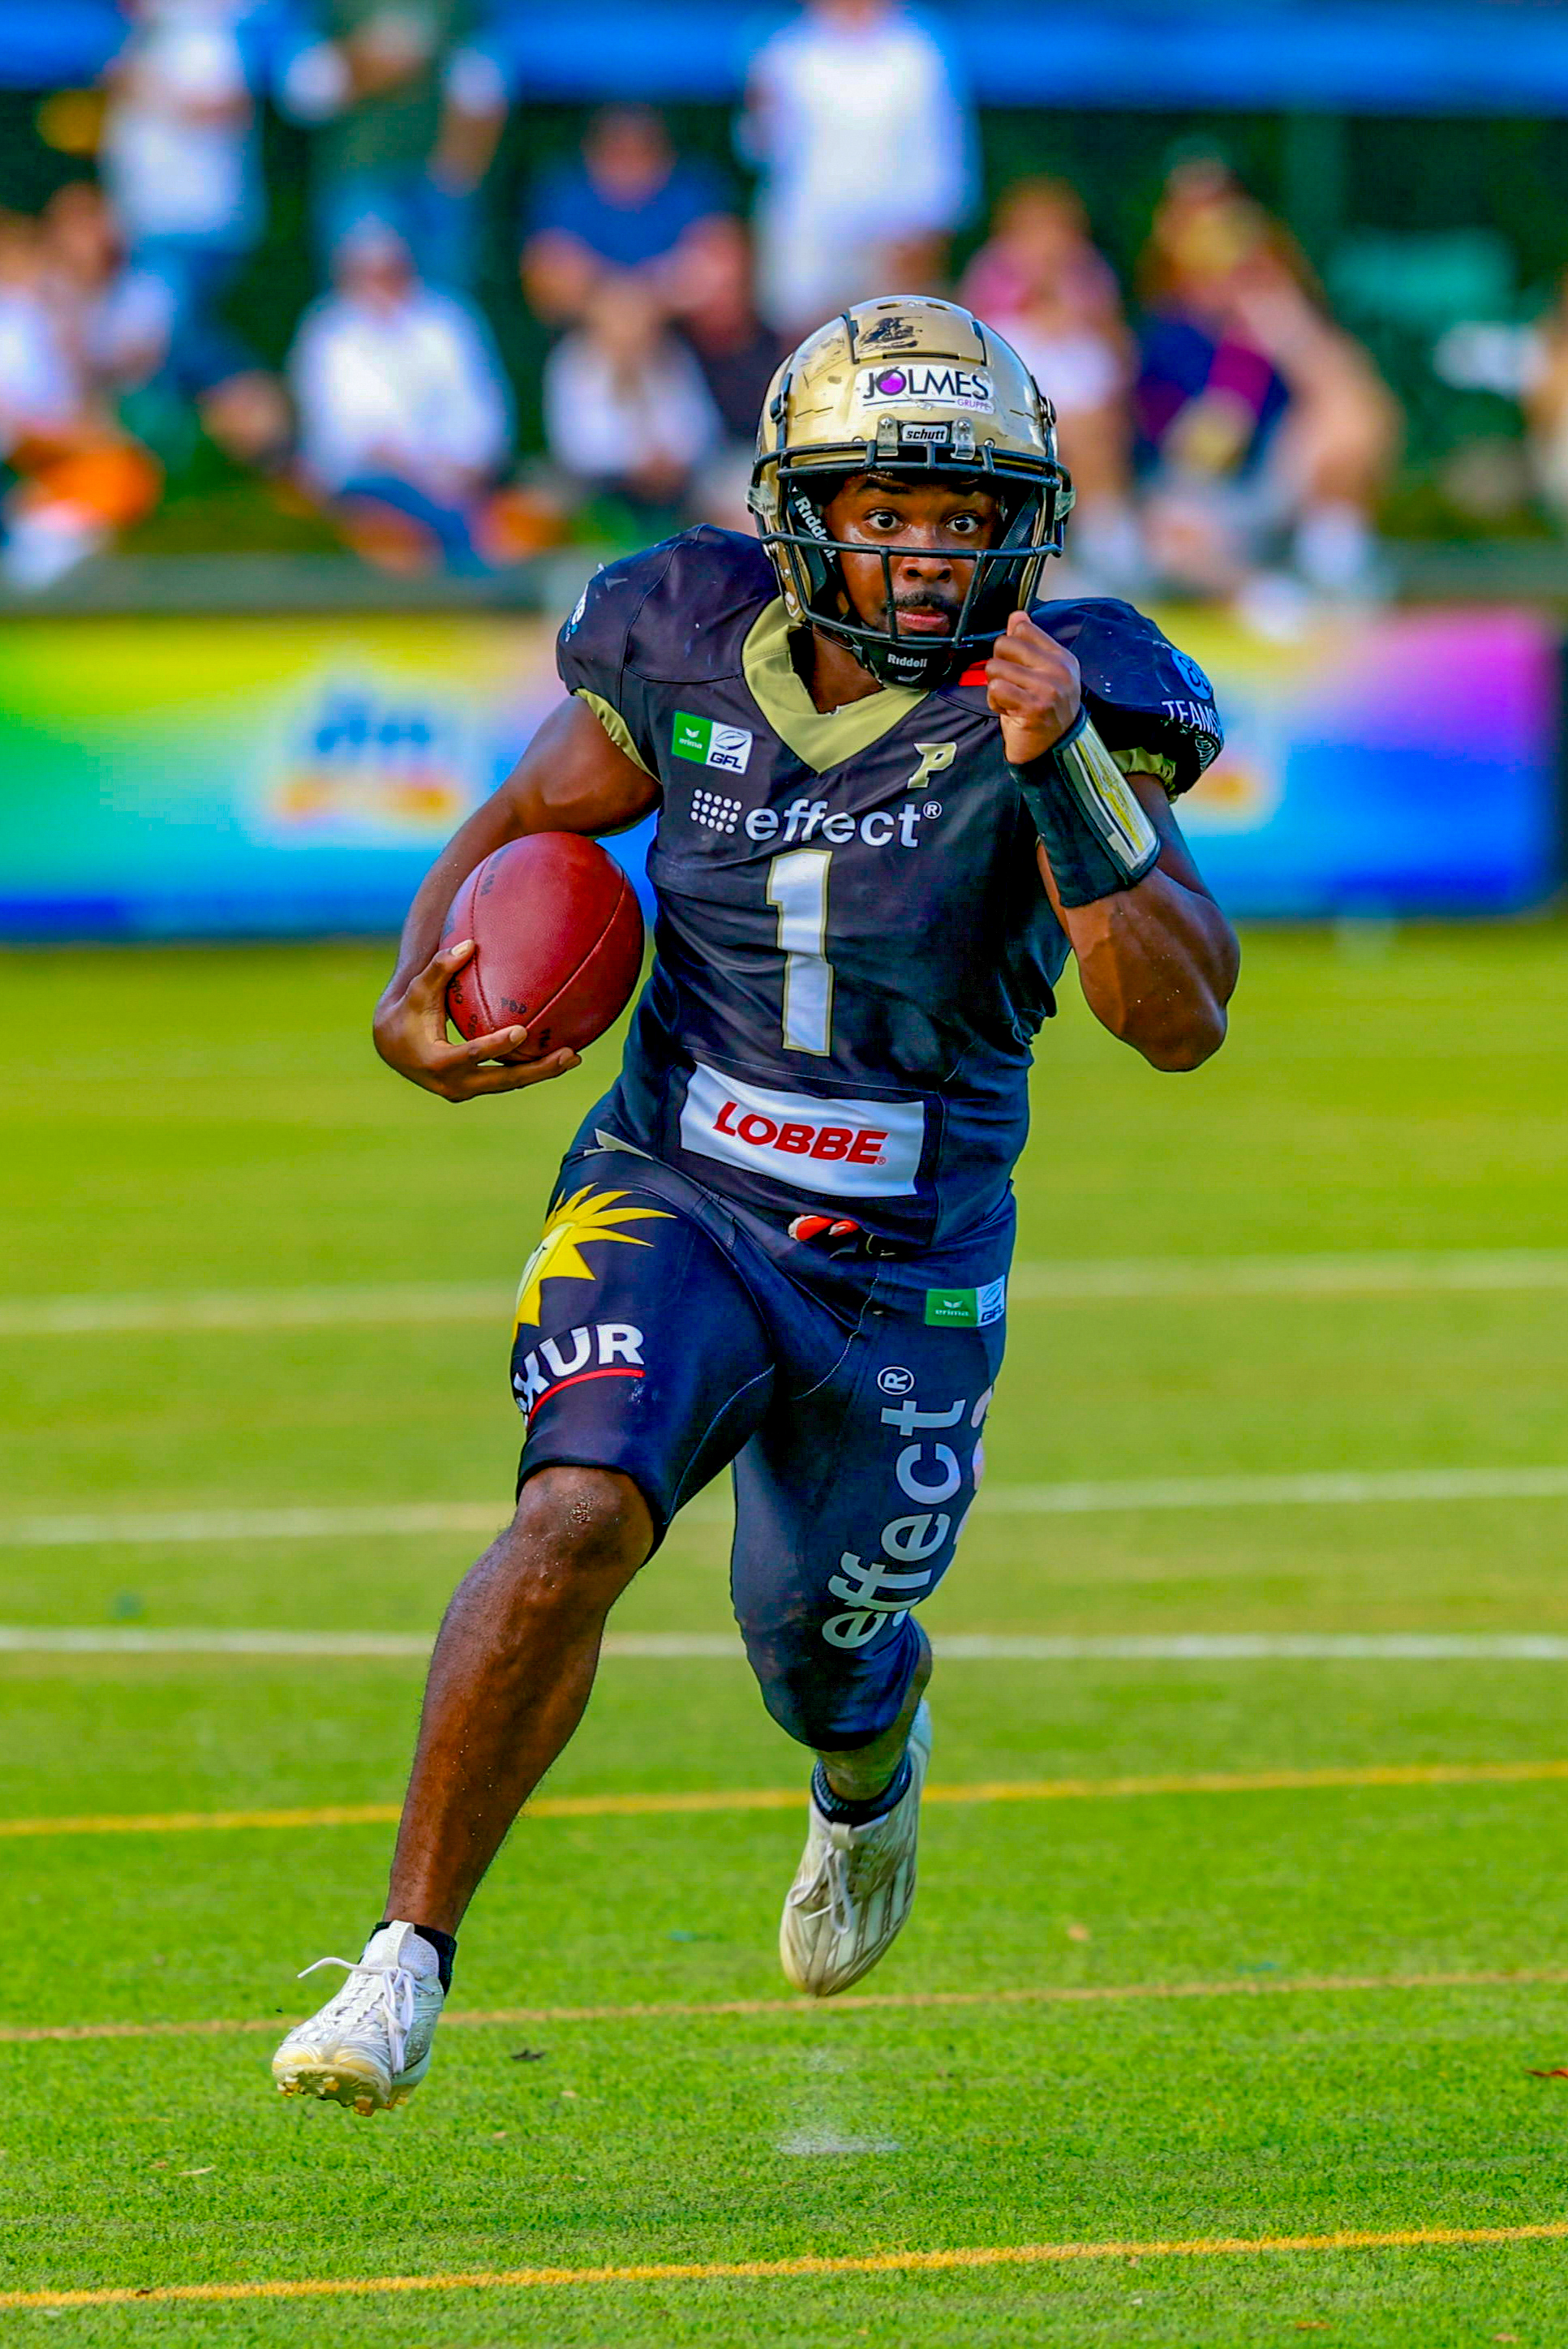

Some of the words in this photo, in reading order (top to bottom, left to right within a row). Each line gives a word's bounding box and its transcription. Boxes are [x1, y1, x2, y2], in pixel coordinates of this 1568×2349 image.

[862, 367, 989, 400] JOLMES
[956, 397, 991, 411] GRUPPE
[905, 428, 945, 440] schutt
[887, 653, 928, 668] Riddell
[679, 737, 703, 749] erima
[710, 752, 743, 770] GFL
[907, 741, 957, 789] P
[765, 847, 835, 1058] 1
